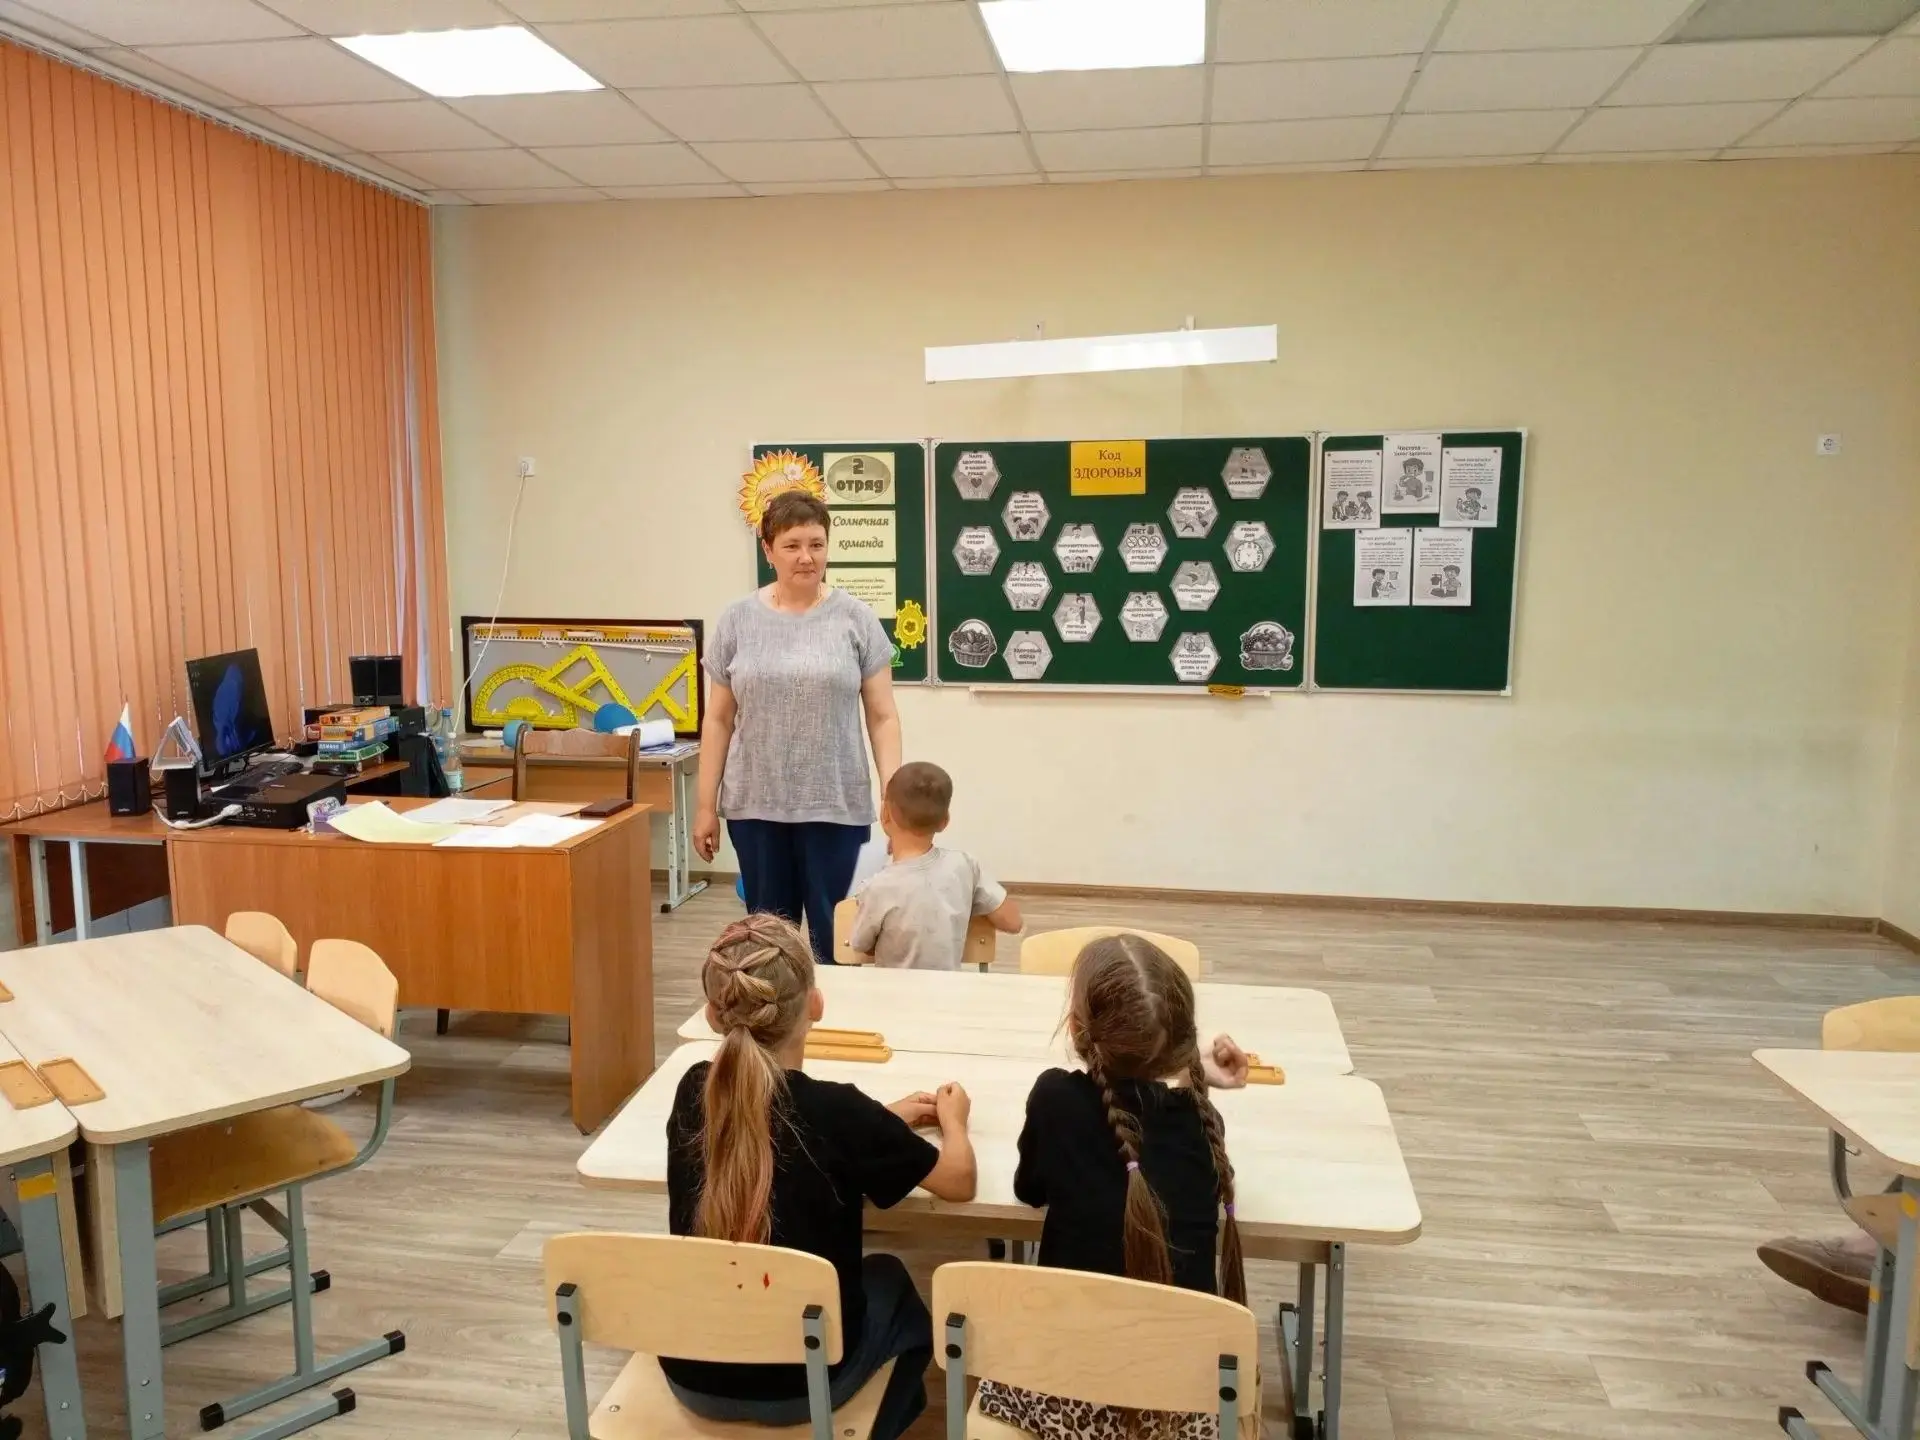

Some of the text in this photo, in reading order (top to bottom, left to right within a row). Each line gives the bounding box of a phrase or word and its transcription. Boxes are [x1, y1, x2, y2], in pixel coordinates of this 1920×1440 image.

[1098, 449, 1122, 461] Код
[852, 458, 864, 475] 2
[1074, 467, 1142, 480] ЗДОРОВЬЯ
[836, 479, 884, 494] отряд
[832, 515, 889, 527] Солнечная
[838, 536, 884, 549] команда
